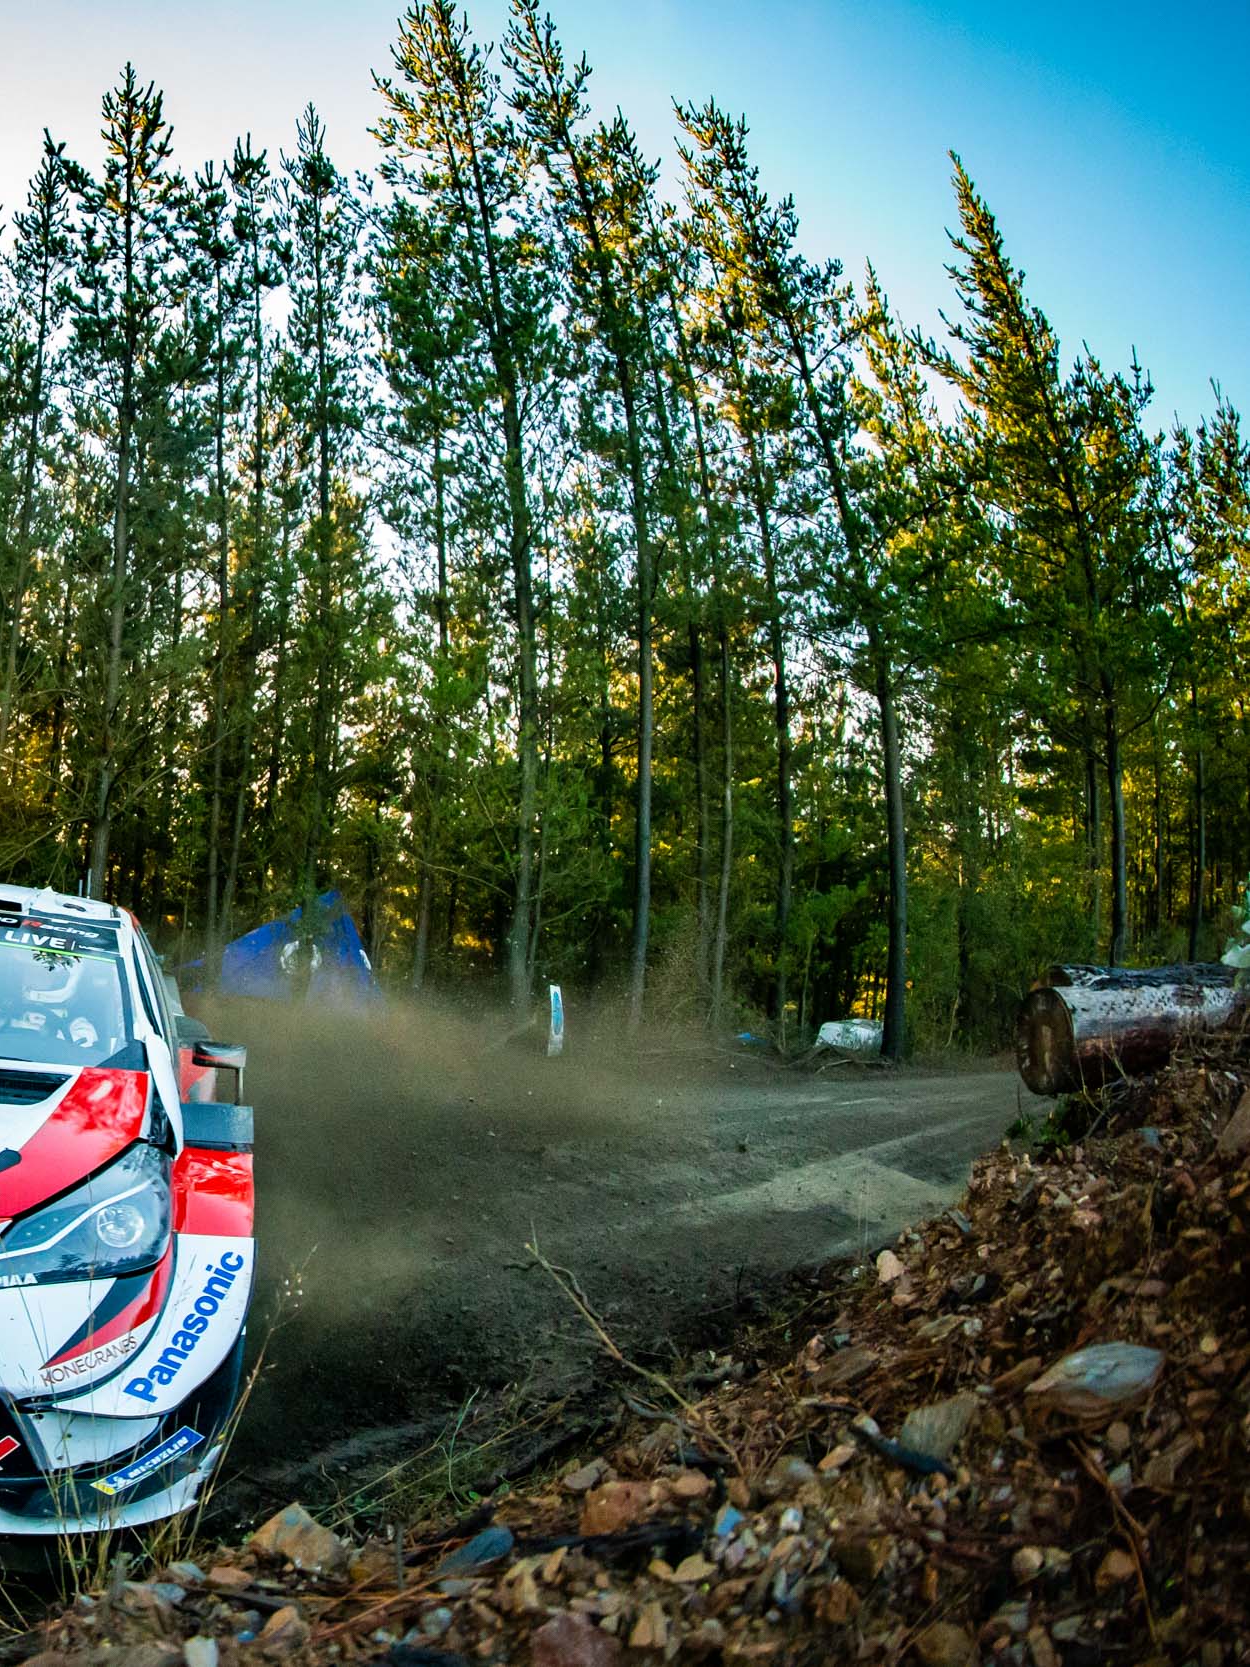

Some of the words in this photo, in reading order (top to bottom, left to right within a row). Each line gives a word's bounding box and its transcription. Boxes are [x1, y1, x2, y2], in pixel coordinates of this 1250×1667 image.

[4, 931, 67, 950] LIVE
[21, 919, 100, 939] Racing
[123, 1251, 244, 1403] Panasonic
[39, 1335, 138, 1387] KONECRANES
[128, 1435, 189, 1479] MICHELIN
